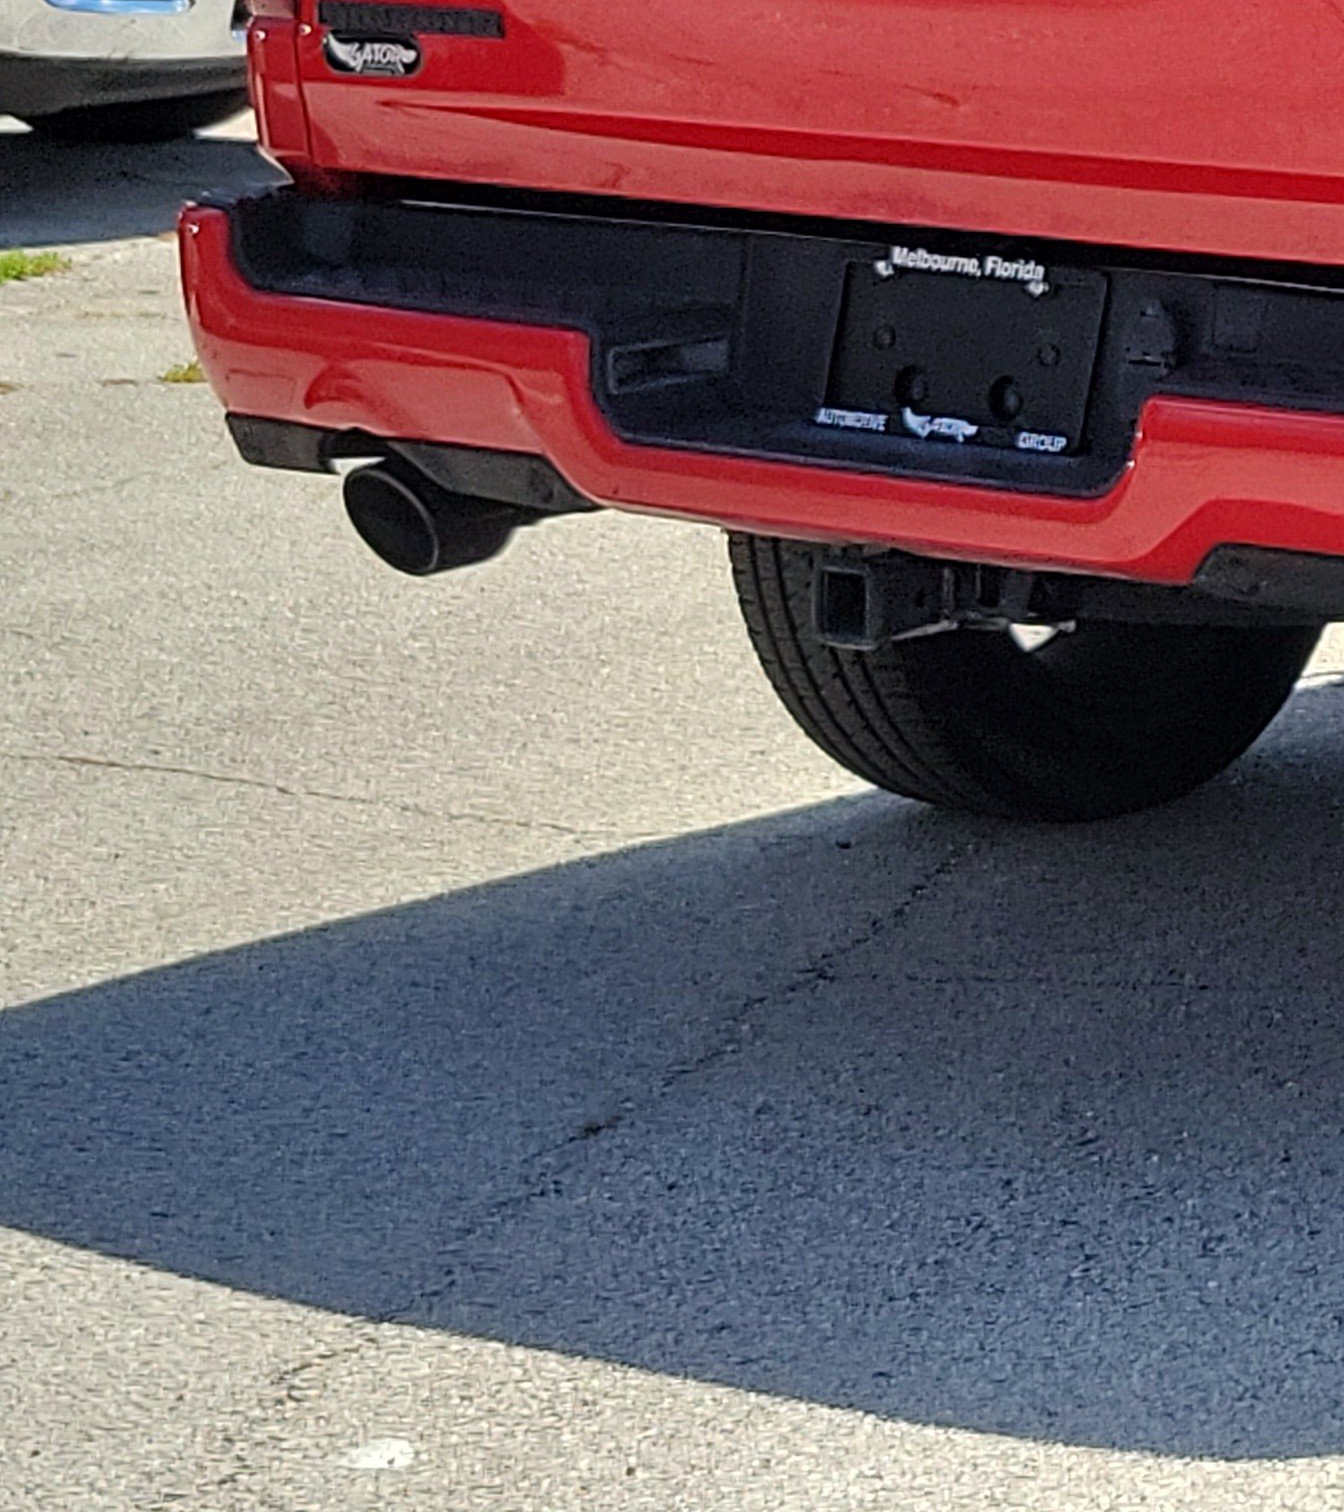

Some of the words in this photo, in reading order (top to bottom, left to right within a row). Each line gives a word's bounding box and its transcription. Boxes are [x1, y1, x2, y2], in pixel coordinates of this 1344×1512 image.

[892, 245, 982, 277] Melbourne,
[984, 255, 1045, 281] Florida
[1016, 431, 1067, 453] GROUP
